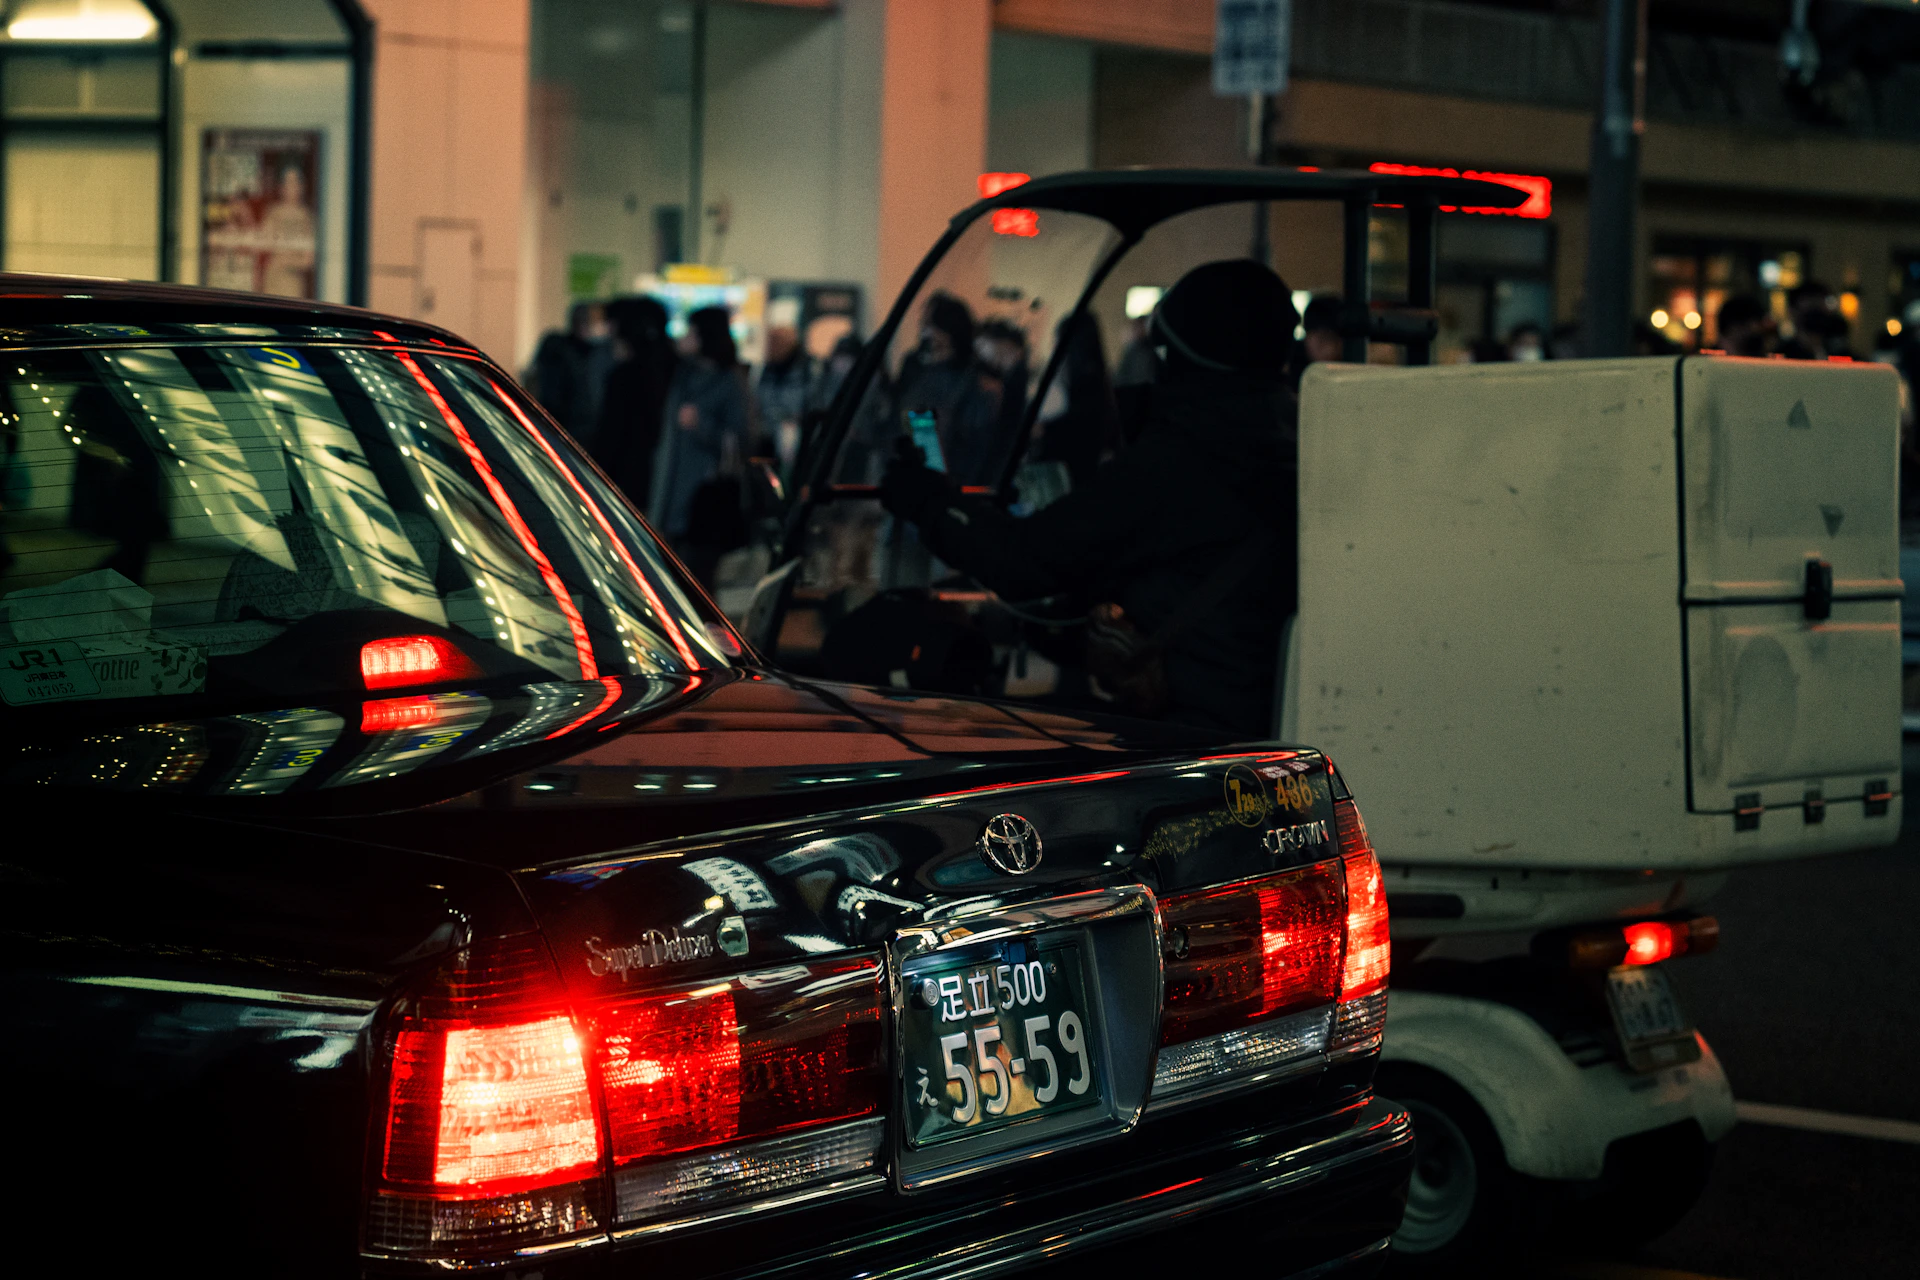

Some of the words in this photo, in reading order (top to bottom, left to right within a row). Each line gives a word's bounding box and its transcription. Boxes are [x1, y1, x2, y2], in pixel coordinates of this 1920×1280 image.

[24, 671, 68, 683] JR東日本
[27, 682, 76, 698] 047052
[1276, 773, 1313, 811] 436
[1260, 819, 1330, 855] CROWN
[585, 936, 645, 982] Super
[643, 926, 714, 967] Deluxe
[916, 1066, 939, 1108] え
[939, 1010, 1092, 1124] 55-59
